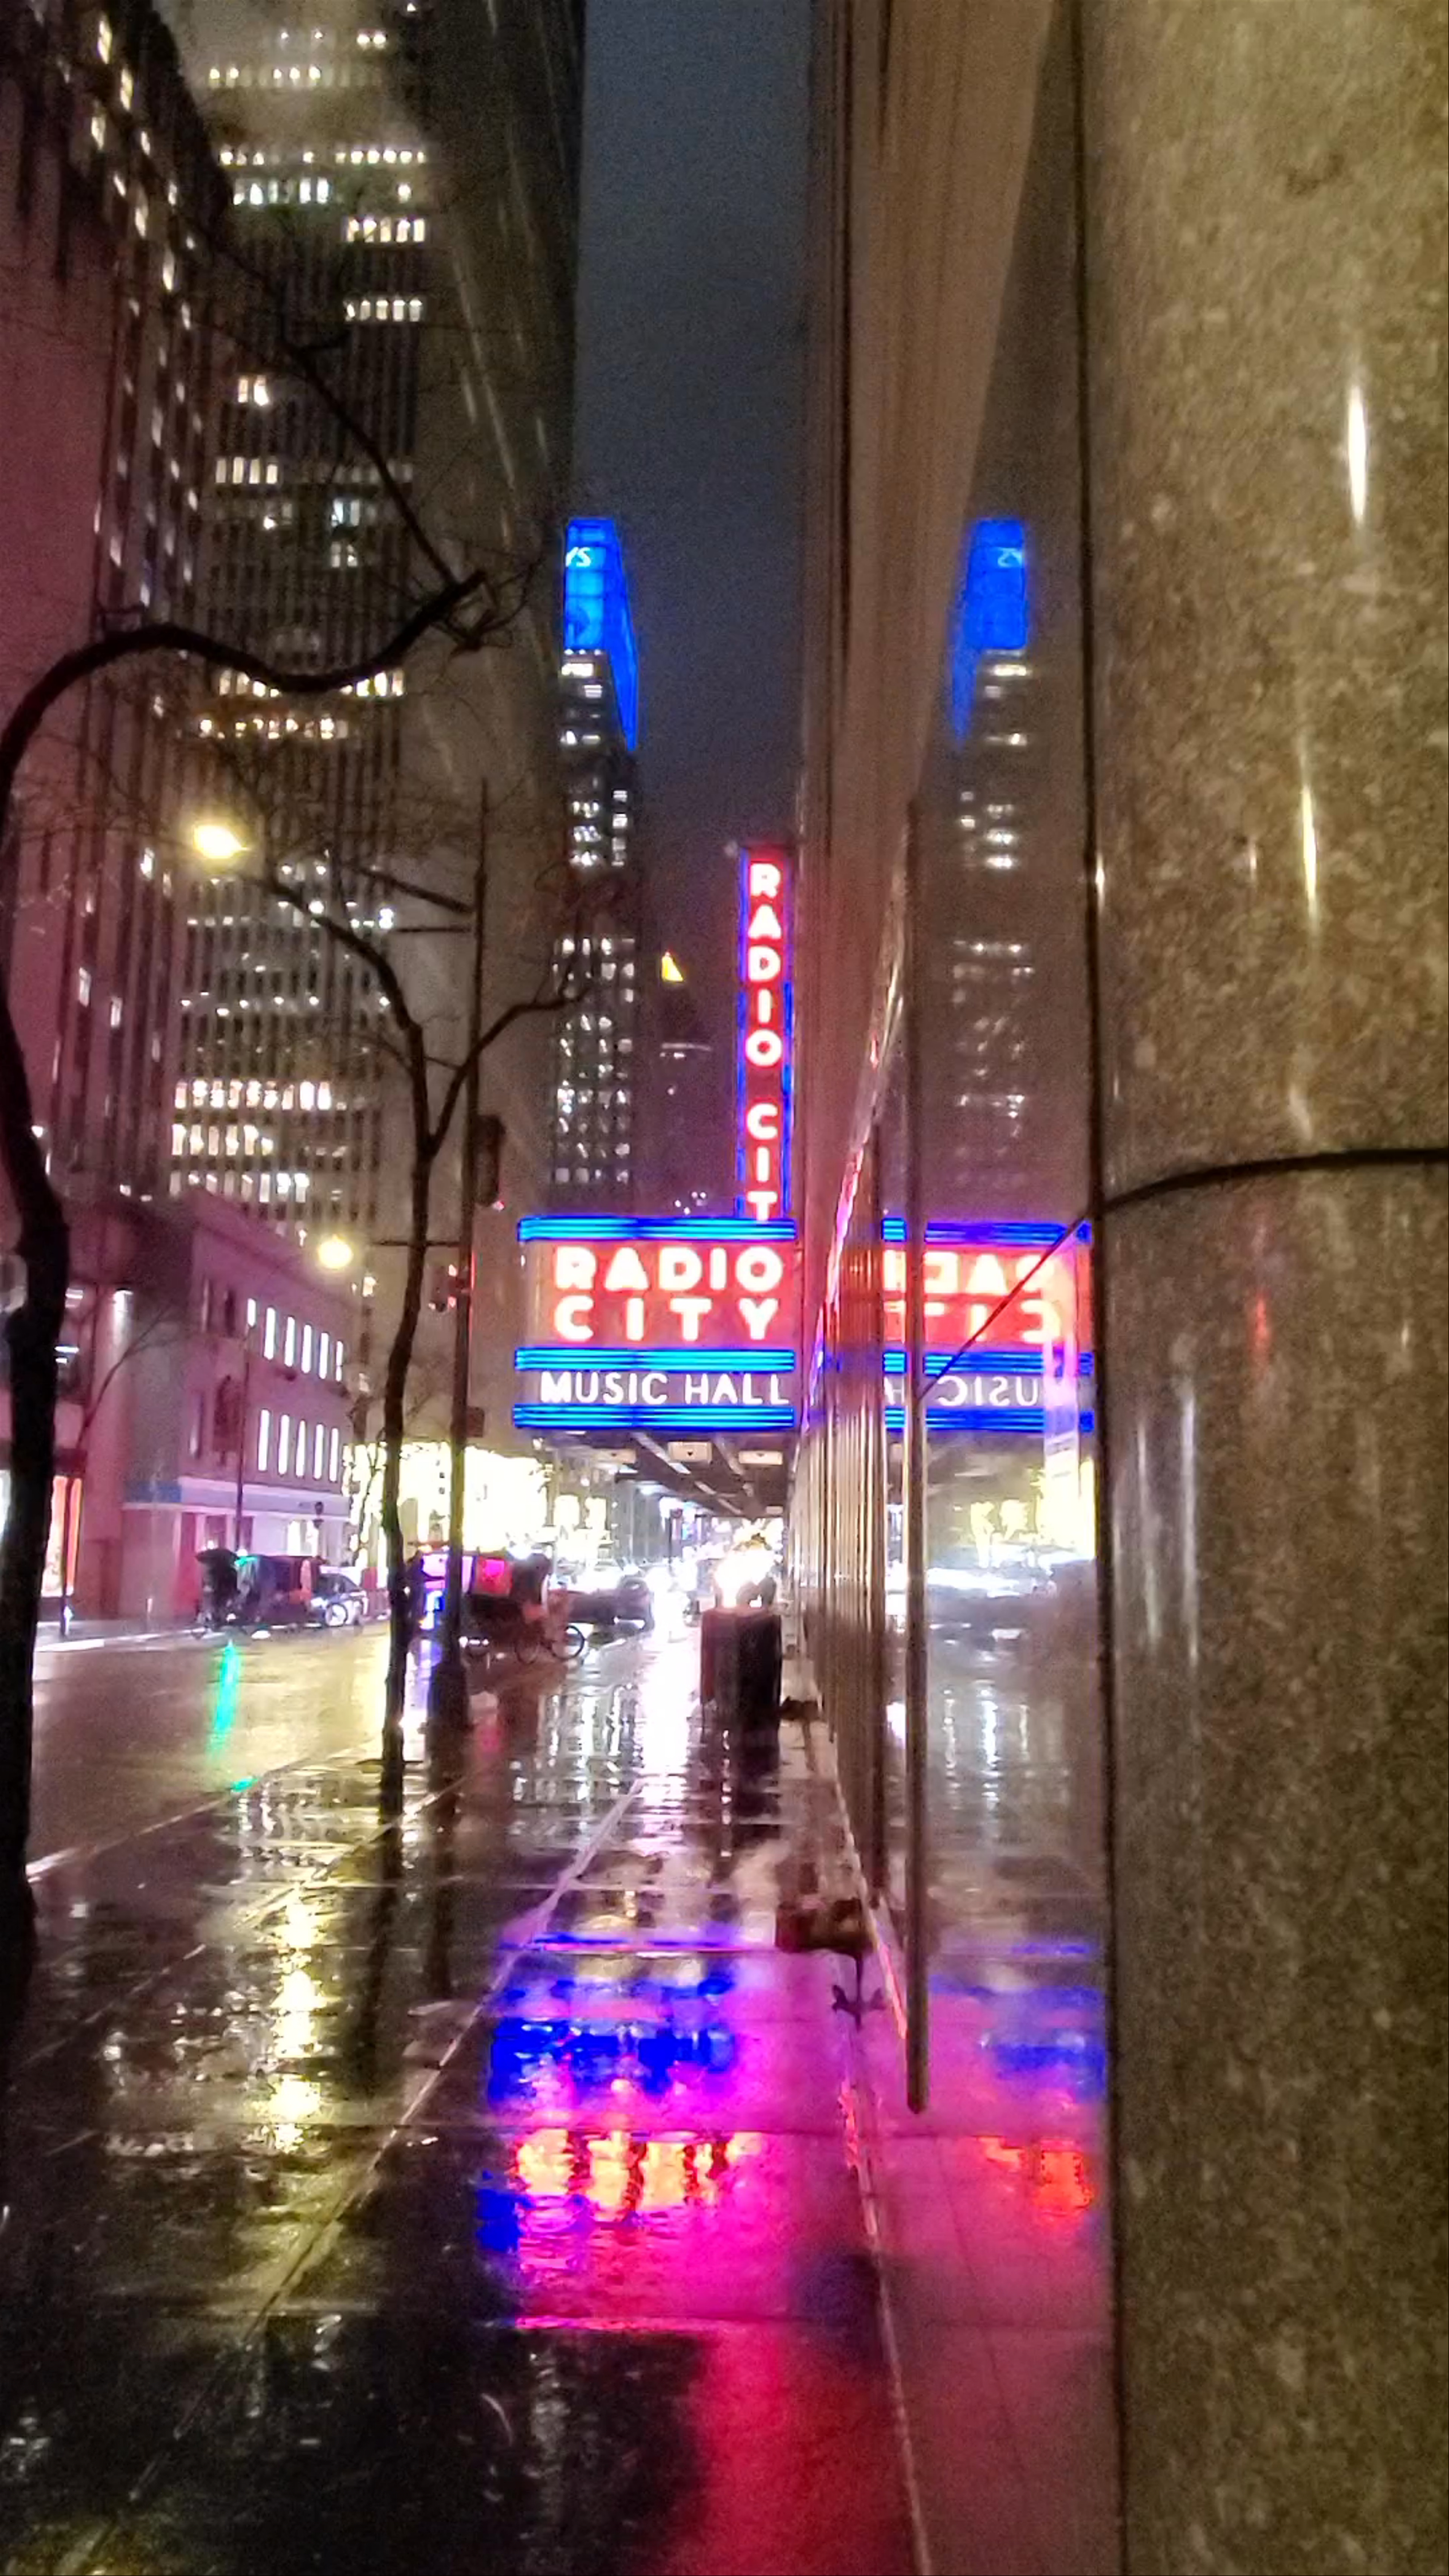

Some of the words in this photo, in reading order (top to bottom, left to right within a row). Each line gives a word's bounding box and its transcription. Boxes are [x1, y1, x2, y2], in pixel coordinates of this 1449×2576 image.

[745, 863, 783, 1066] RADIO
[747, 1103, 778, 1222] CIT
[555, 1246, 783, 1292] RADIO
[555, 1295, 778, 1341] CITY
[541, 1371, 668, 1404] MUSIC
[685, 1373, 789, 1404] HALL
